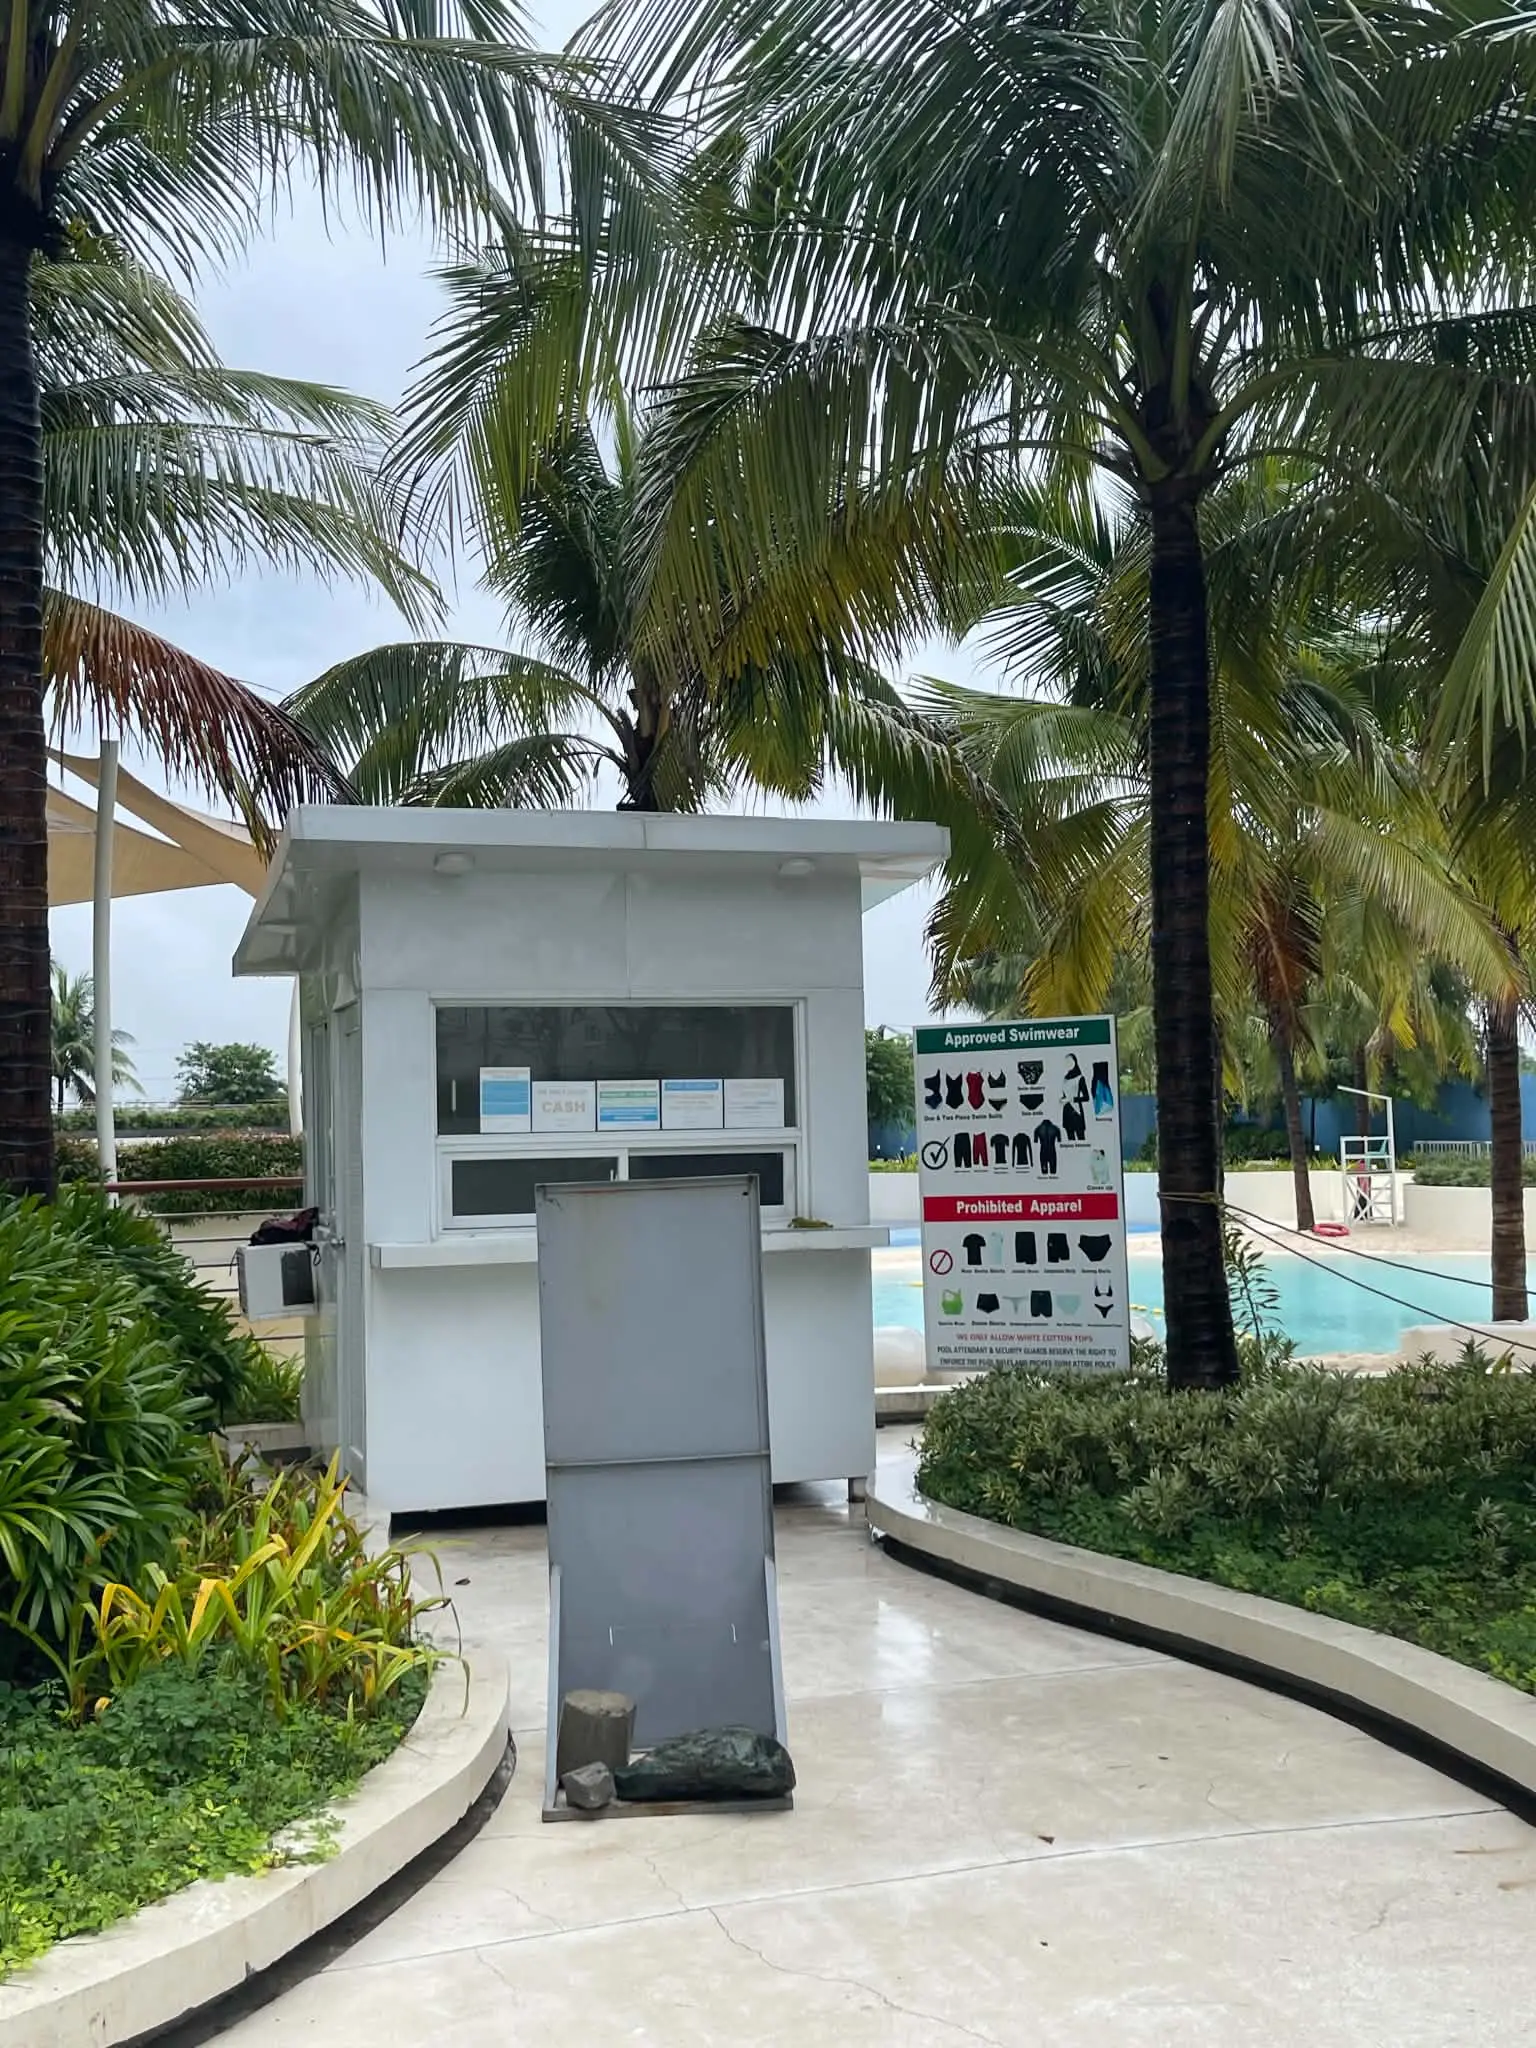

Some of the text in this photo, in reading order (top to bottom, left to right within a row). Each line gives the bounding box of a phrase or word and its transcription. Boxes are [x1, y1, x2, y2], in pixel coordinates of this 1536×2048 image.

[944, 1026, 1080, 1047] Approved Swimwear
[541, 1100, 586, 1113] CASH
[956, 1198, 1082, 1216] Prohibited Apparel
[990, 1333, 1016, 1342] ALLOW
[1016, 1334, 1041, 1342] WHITE
[1043, 1334, 1073, 1342] COTTON
